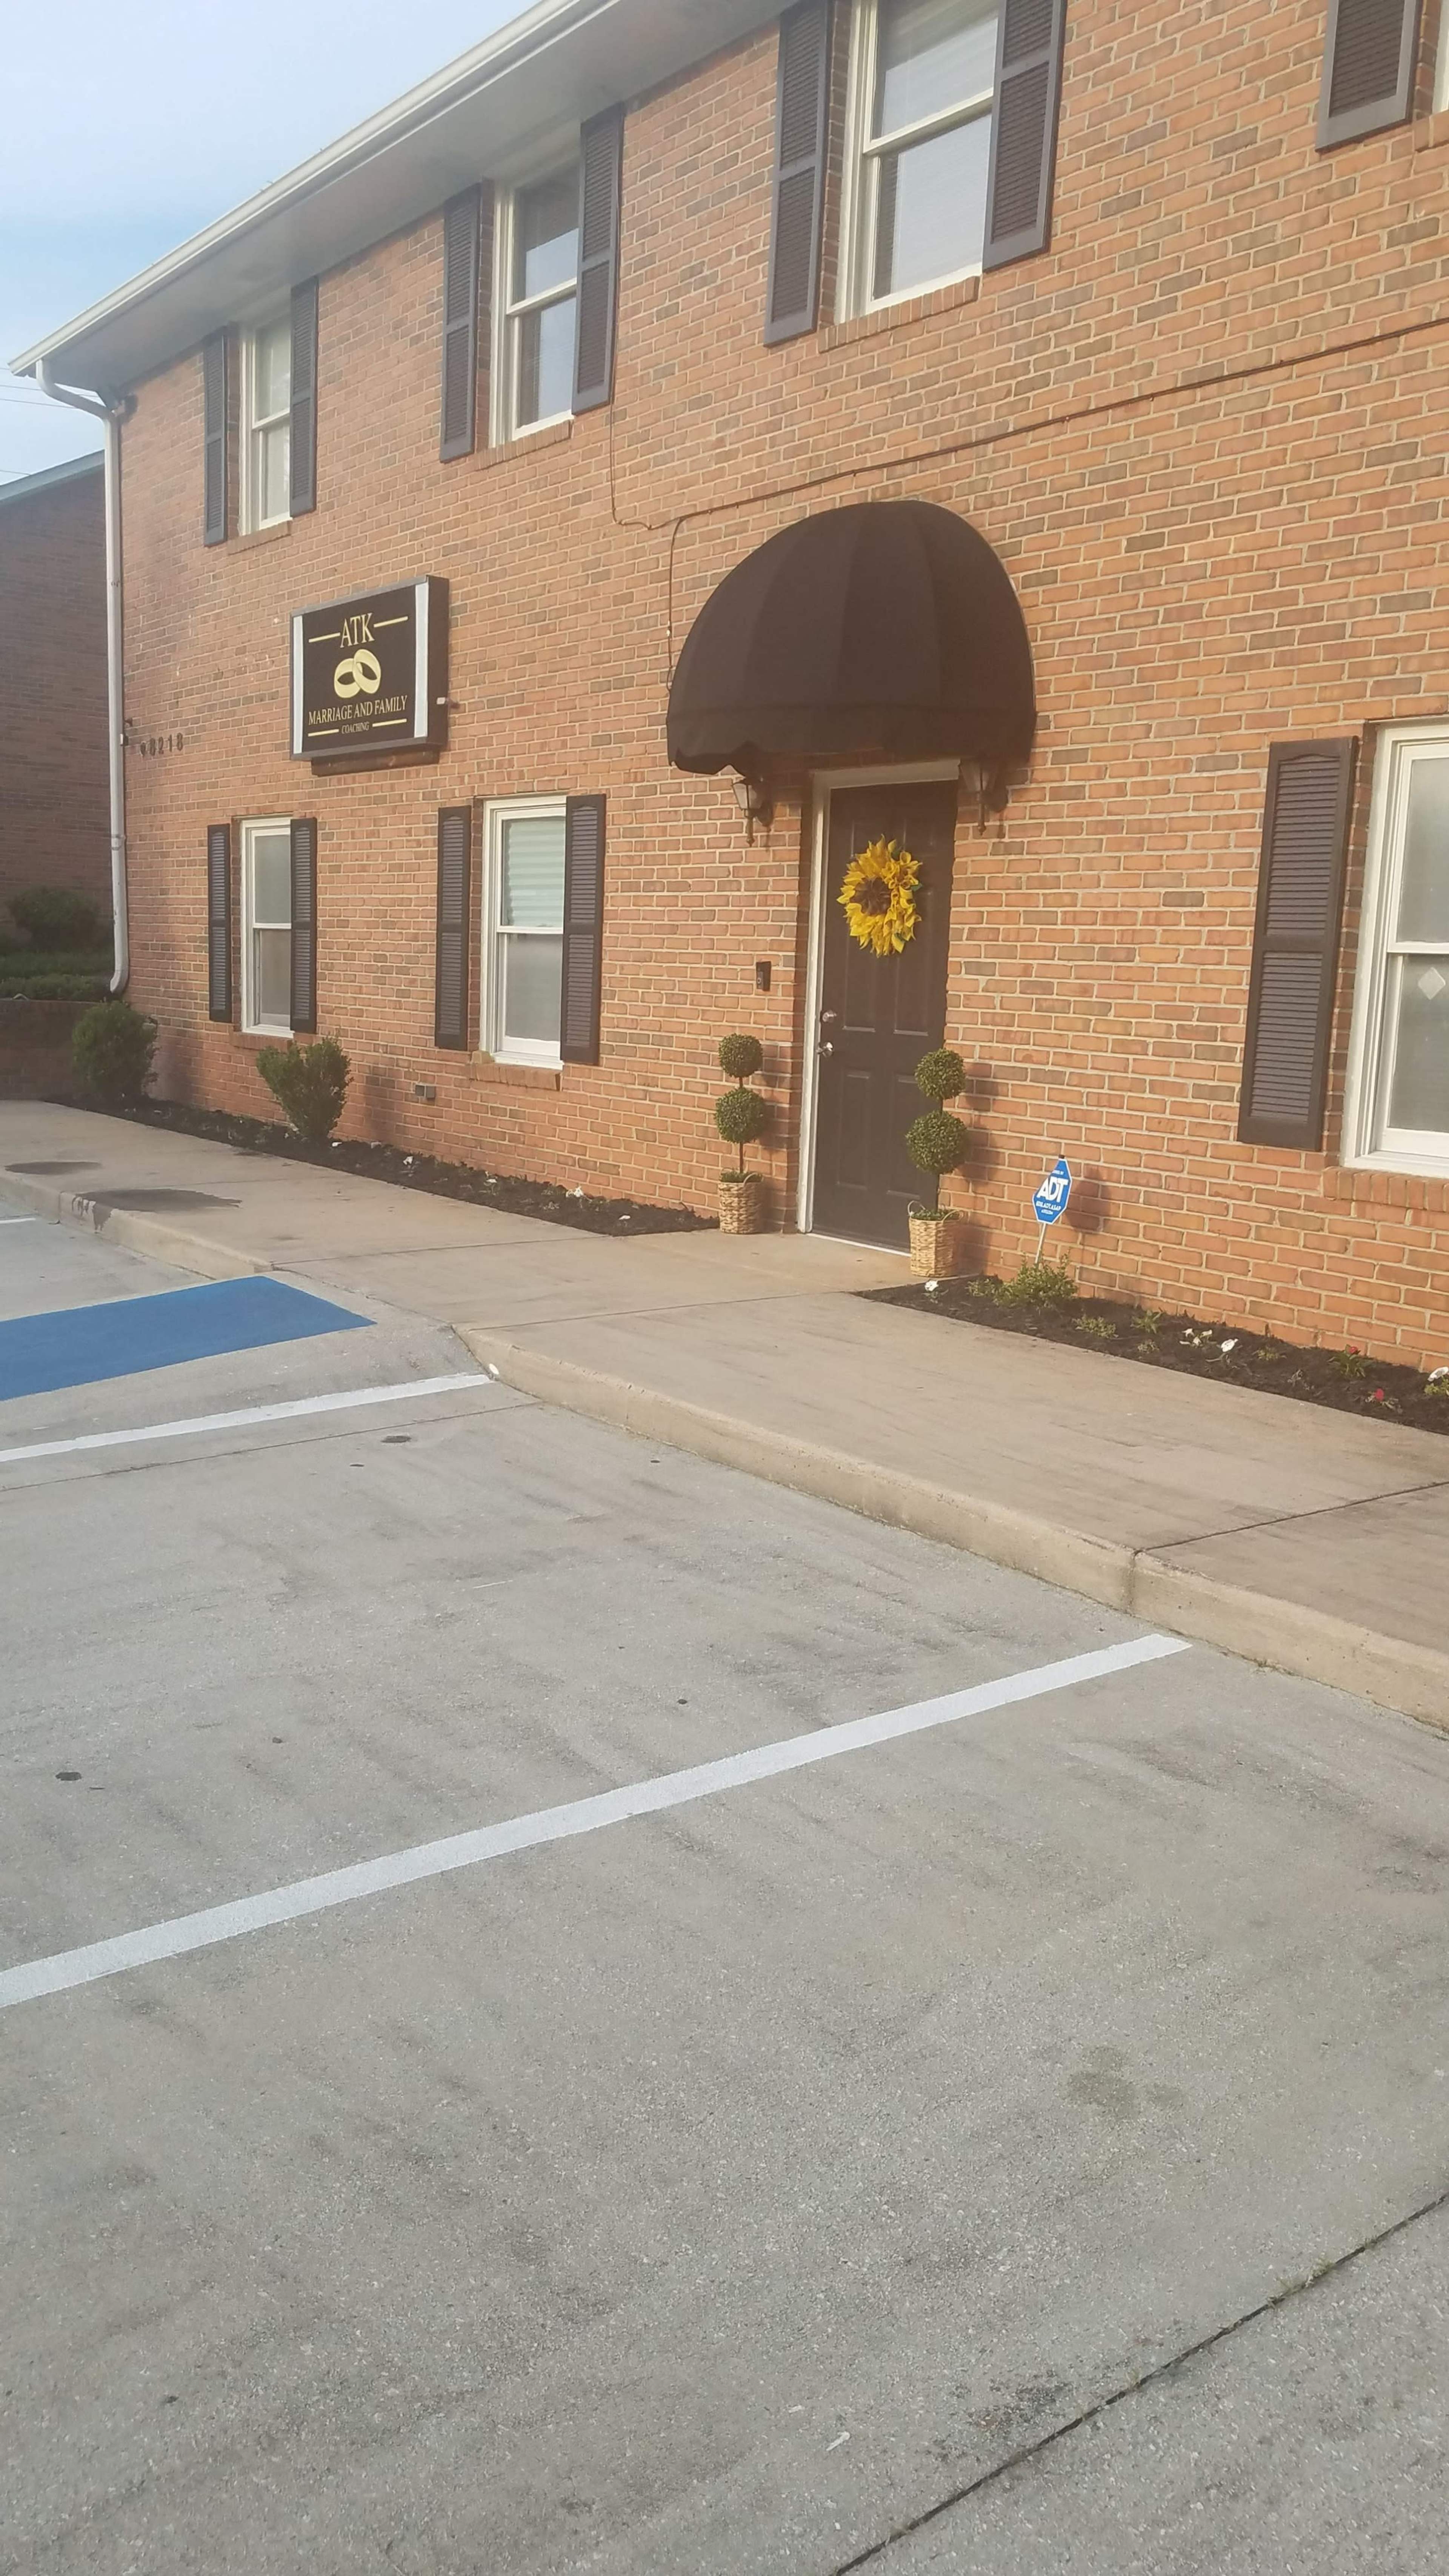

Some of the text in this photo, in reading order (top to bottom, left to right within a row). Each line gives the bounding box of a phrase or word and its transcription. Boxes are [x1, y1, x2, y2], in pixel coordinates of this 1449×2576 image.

[340, 613, 375, 648] ATK
[308, 695, 408, 725] MARRIAGE AND FAMILY
[341, 721, 369, 734] COACHING
[1036, 1176, 1069, 1203] ADT
